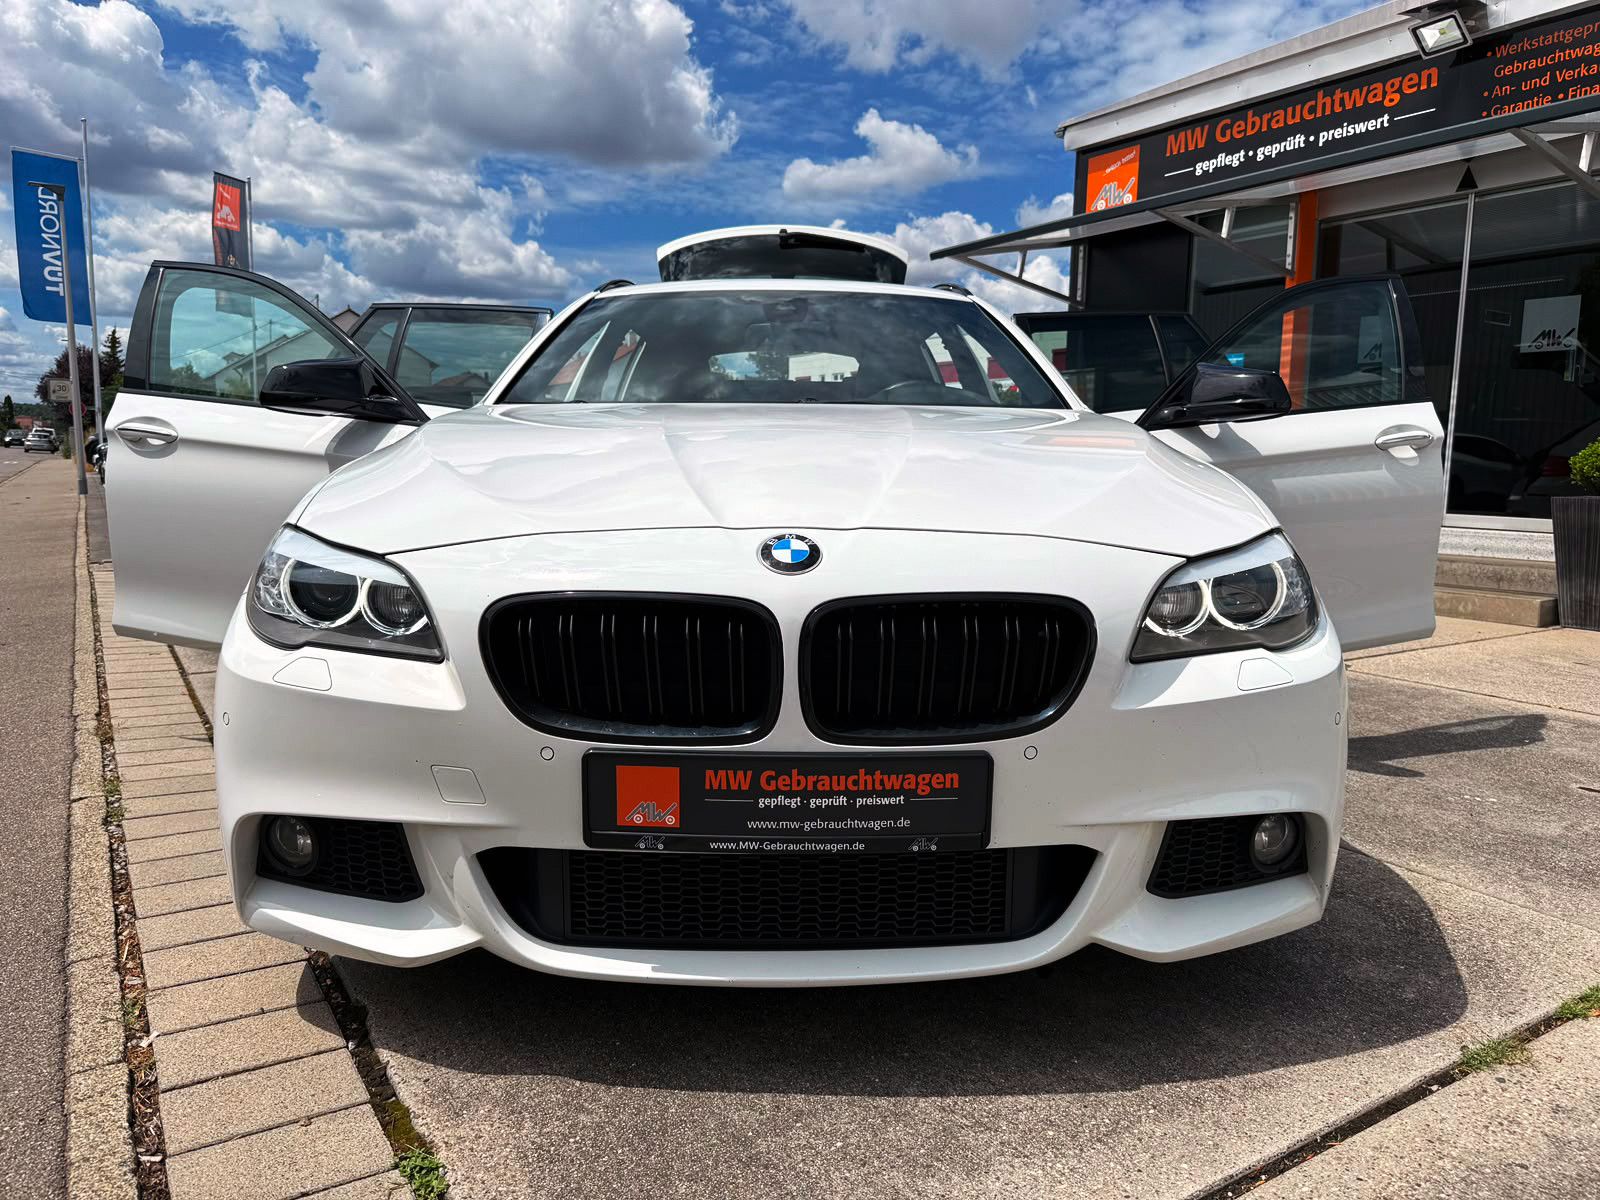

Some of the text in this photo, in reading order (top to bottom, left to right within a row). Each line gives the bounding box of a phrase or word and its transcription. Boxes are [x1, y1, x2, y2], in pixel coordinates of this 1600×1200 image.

[1494, 42, 1600, 78] Gebrauchtwag
[1491, 85, 1517, 99] An-
[1521, 71, 1551, 91] und
[1165, 66, 1439, 157] MW Gebrauchtwagen
[1490, 93, 1552, 117] Garantie
[1195, 113, 1390, 176] gepflegt geprüft preiswert
[56, 384, 67, 393] 30
[705, 768, 959, 796] MW Gebrauchtwagen
[758, 795, 905, 809] gepflegt geprüft preiswert
[747, 816, 911, 832] www.mw-gebrauchtwagen.de
[709, 840, 866, 853] www.MW-Gebrauchtwagen.de
